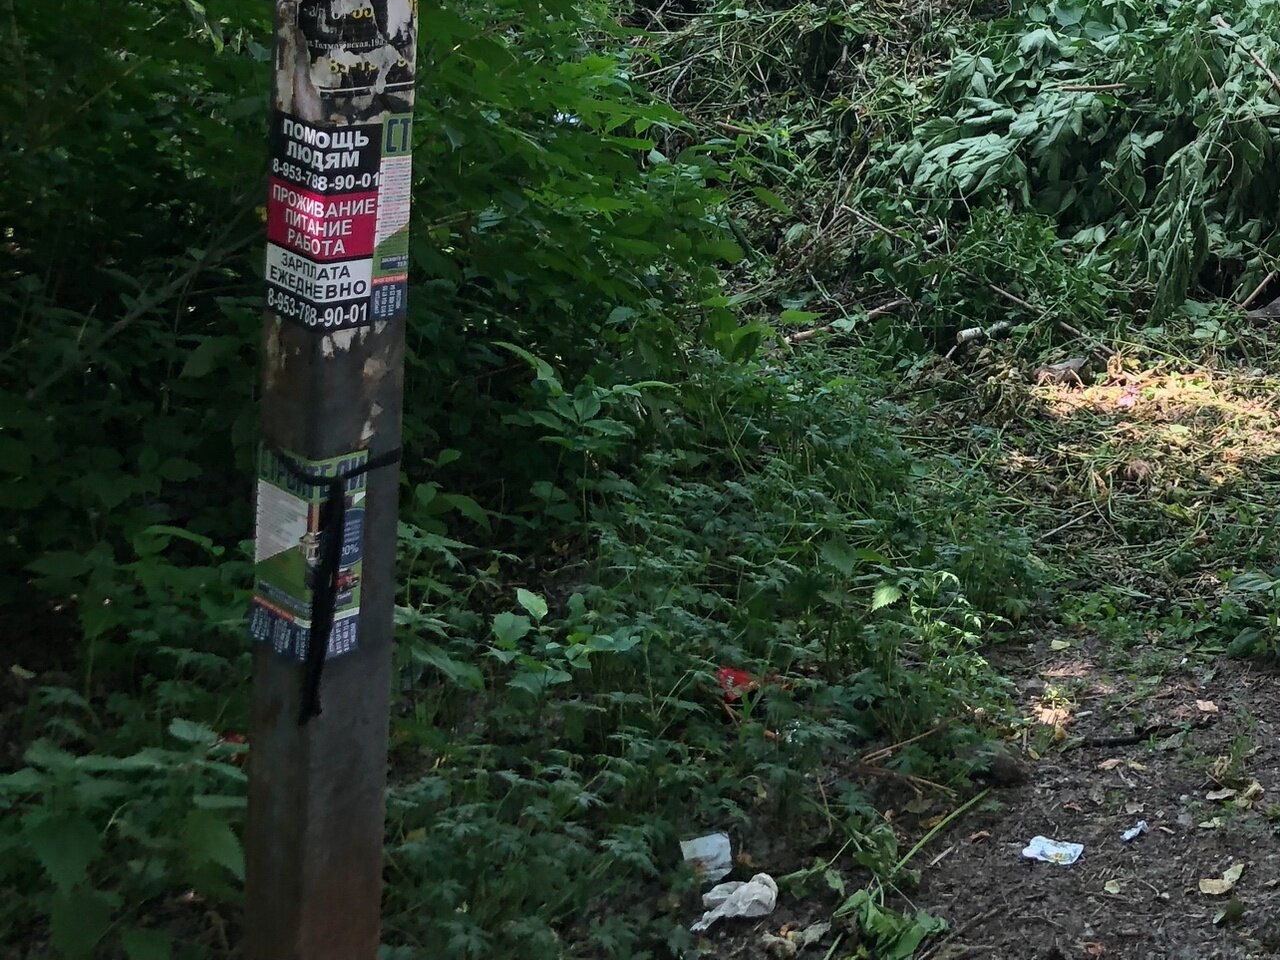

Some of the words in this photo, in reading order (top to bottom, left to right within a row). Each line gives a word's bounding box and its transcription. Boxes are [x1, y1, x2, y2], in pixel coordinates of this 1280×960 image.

[283, 119, 370, 151] ПОМОЩЬ
[286, 141, 360, 172] ЛЮДЯМ
[273, 158, 379, 192] 8-953-788-90-01
[273, 184, 375, 219] ПРОЖИВАНИЕ
[285, 208, 353, 237] ПИТАНИЕ
[287, 231, 346, 256] РАБОТА
[280, 252, 351, 281] ЗАРПЛАТА
[270, 266, 367, 300] ЕЖЕДНЕВНО
[267, 287, 368, 327] 8-953-788-90-01
